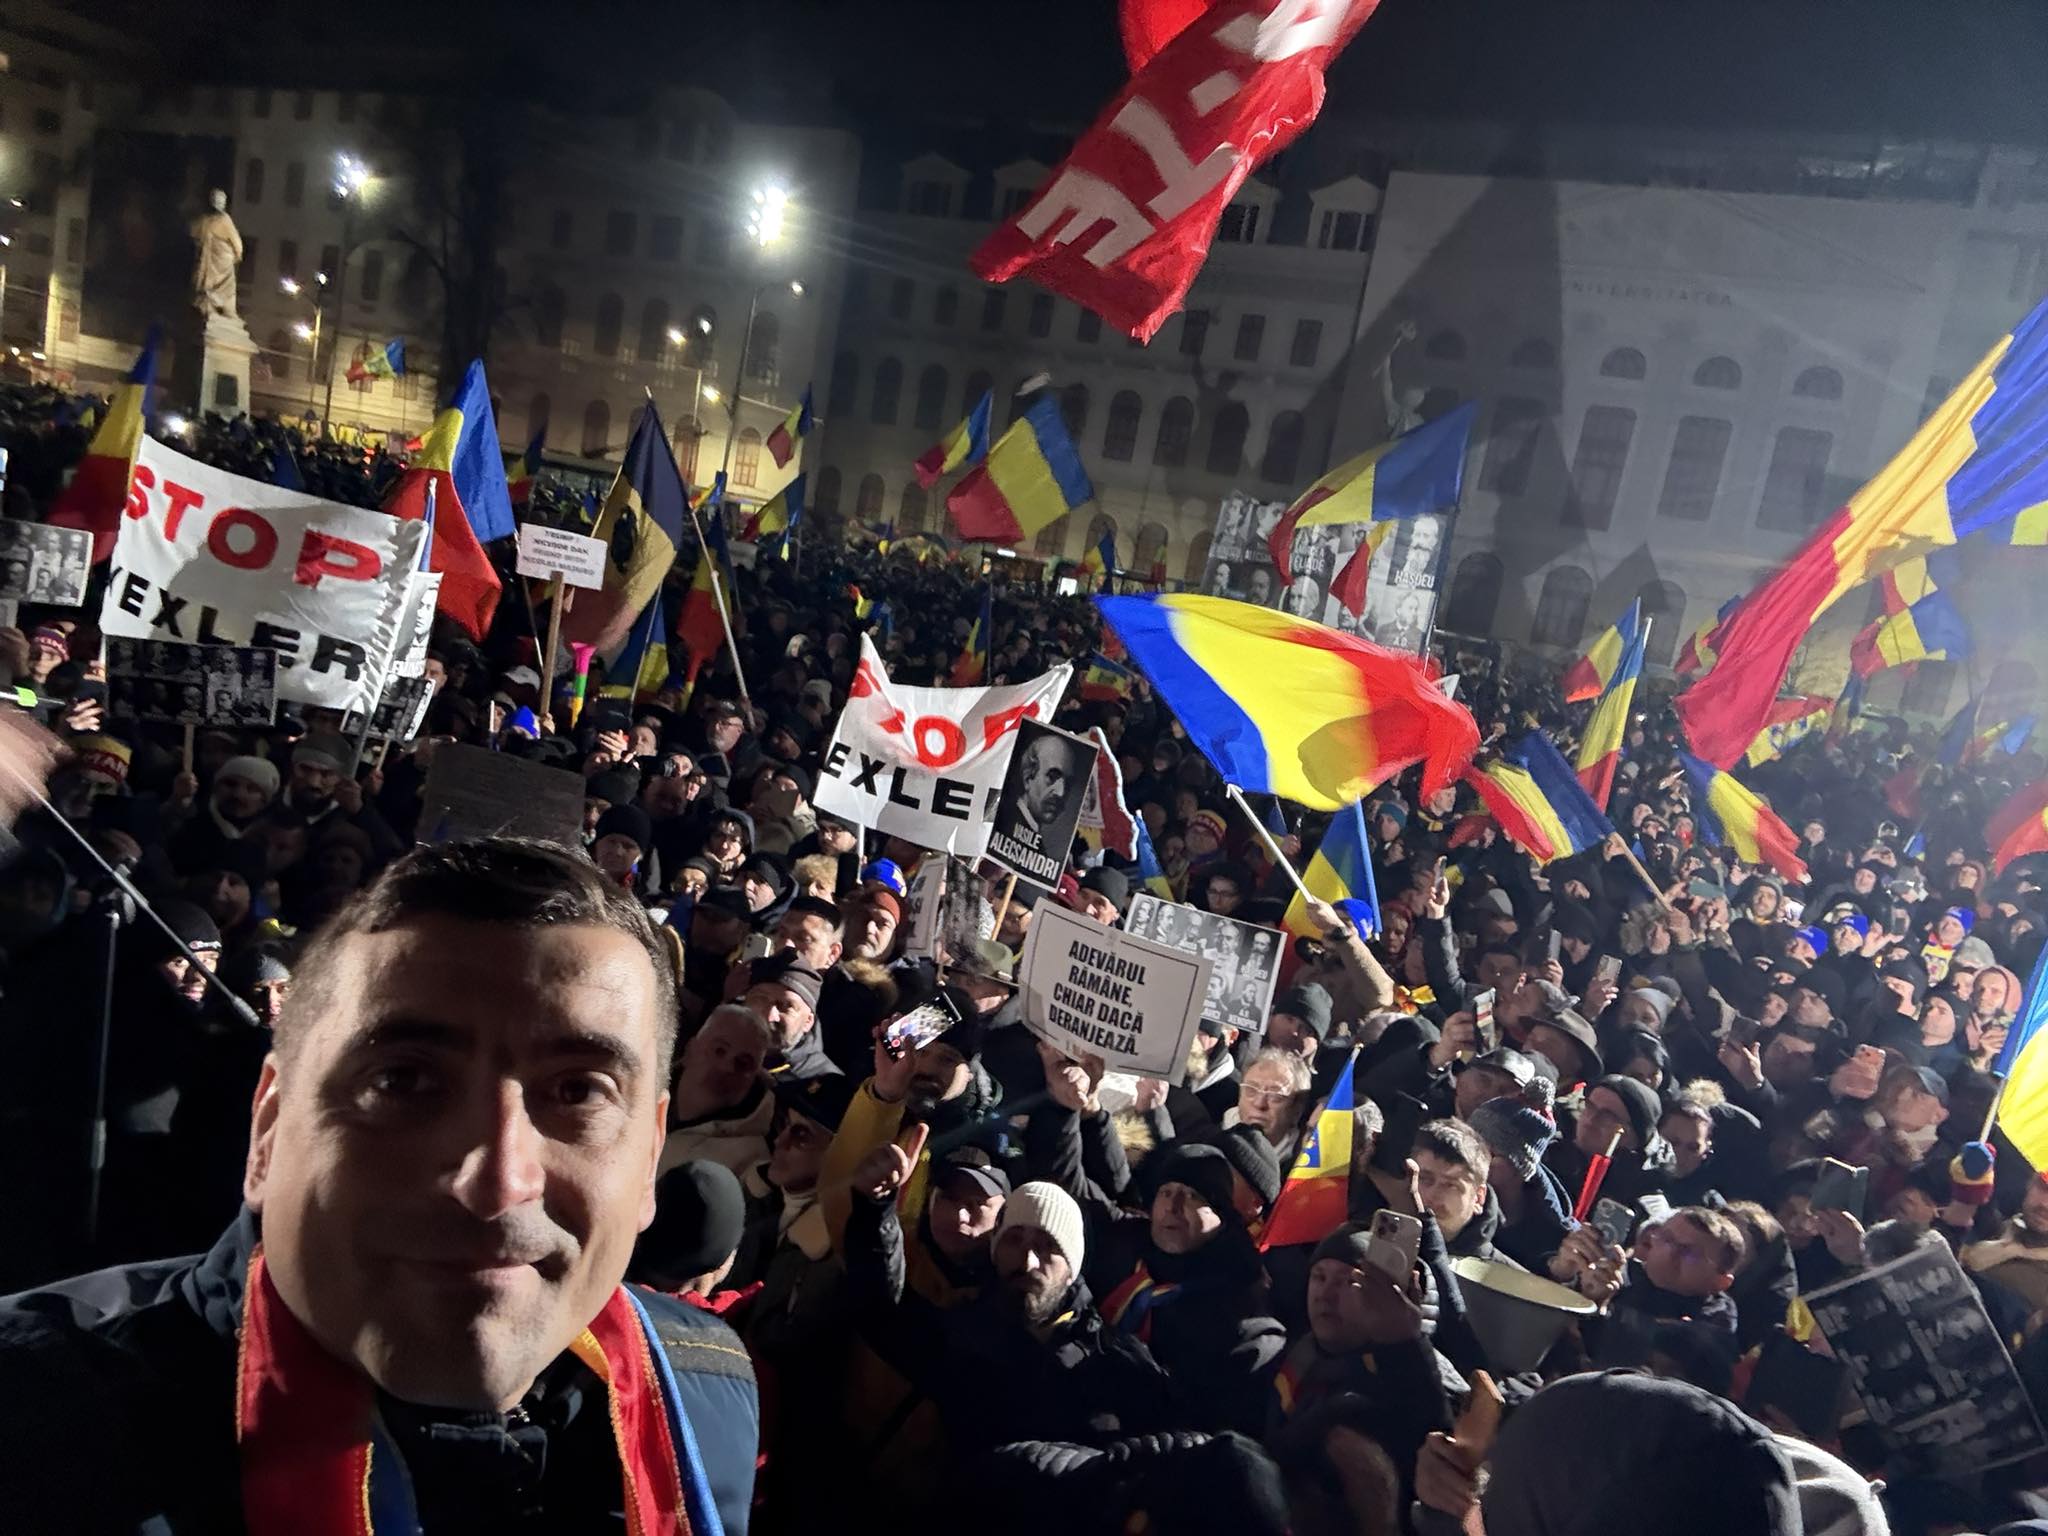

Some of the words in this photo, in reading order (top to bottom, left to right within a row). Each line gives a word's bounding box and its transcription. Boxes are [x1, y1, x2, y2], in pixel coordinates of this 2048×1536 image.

[126, 463, 383, 590] STOP
[1394, 570, 1435, 589] HASDEU
[990, 832, 1060, 881] ALECSANDRI
[1013, 824, 1042, 850] VASILE
[1068, 940, 1146, 985] ADEVĂRUL
[1048, 1003, 1139, 1056] DERANJEAZĂ.
[1053, 982, 1095, 1017] CHIAR
[1097, 1002, 1144, 1034] DACĂ
